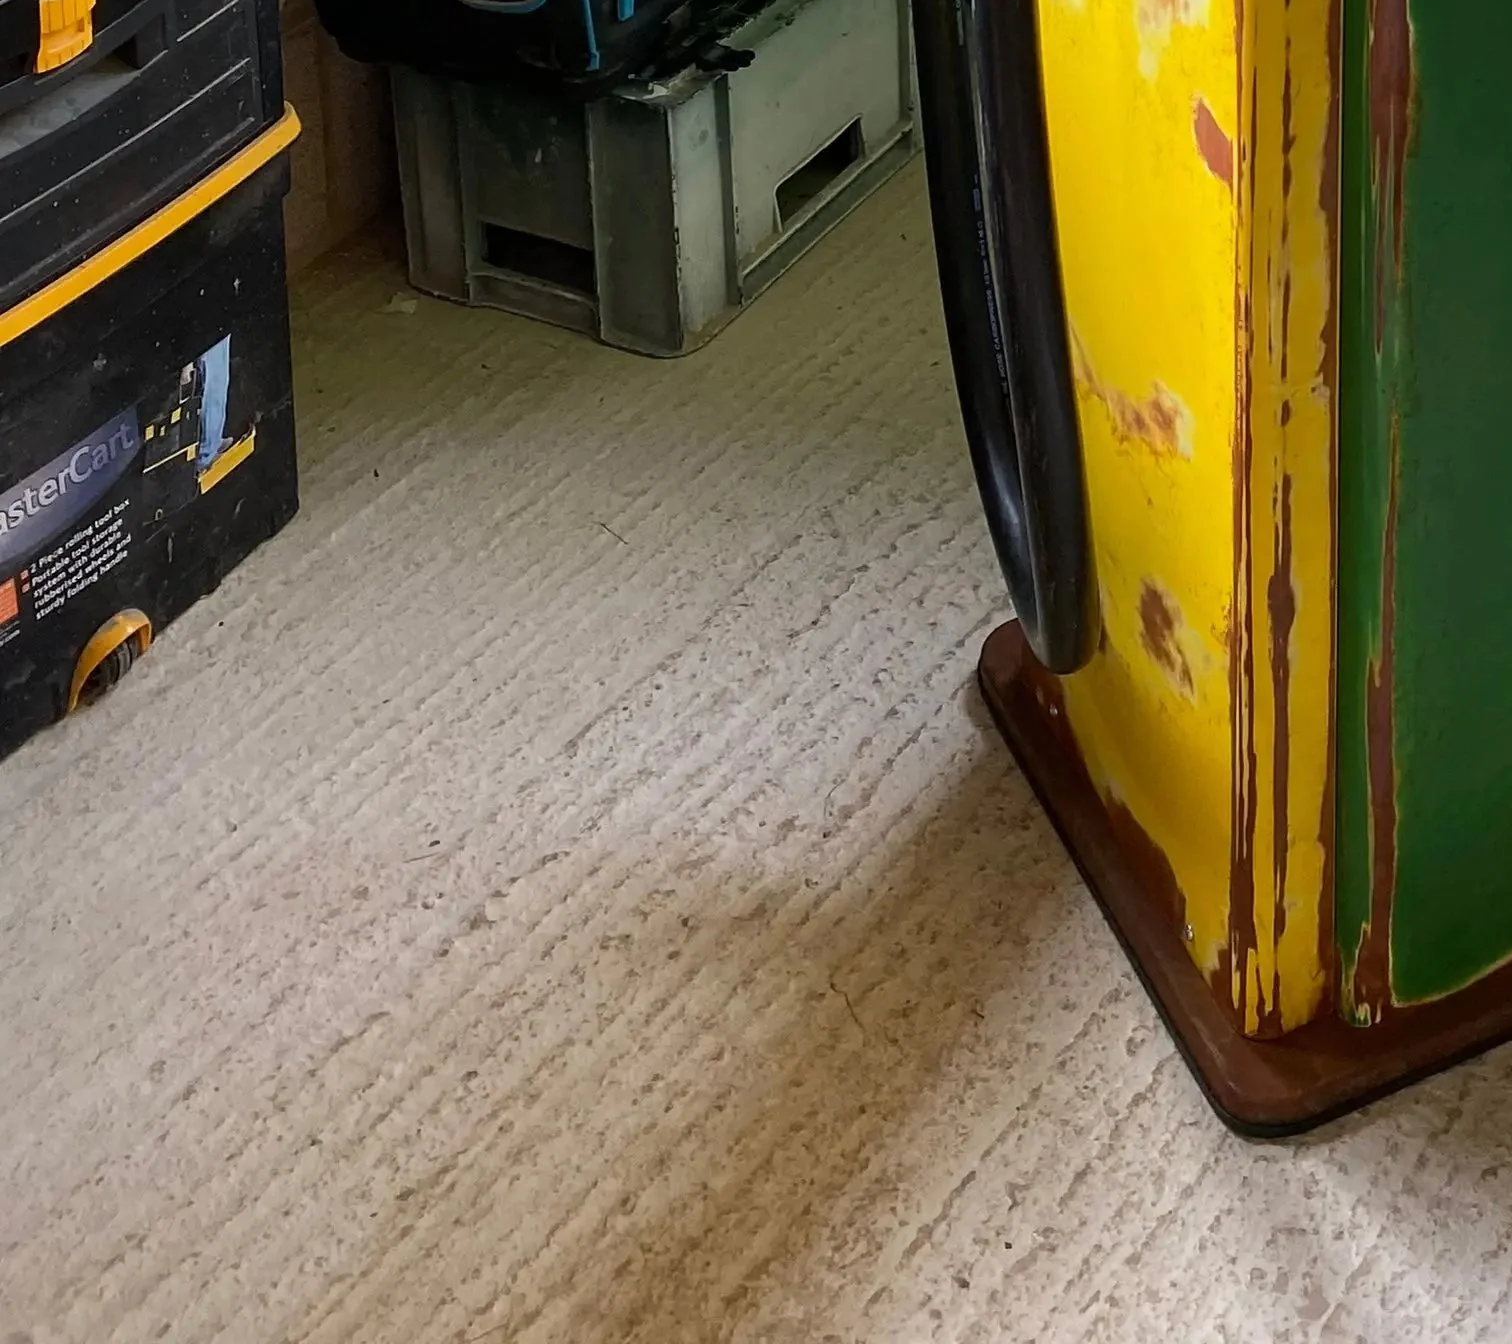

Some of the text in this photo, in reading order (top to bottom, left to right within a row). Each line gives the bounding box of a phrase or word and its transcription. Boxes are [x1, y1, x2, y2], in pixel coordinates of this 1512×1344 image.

[0, 423, 134, 533] asterCart
[29, 499, 130, 574] 2 Piece rolling tool box
[32, 518, 123, 587] Portable tool storage
[33, 531, 122, 598] system with durable
[35, 533, 131, 609] rubberised wheels and
[36, 550, 128, 620] sturdy folding handle
